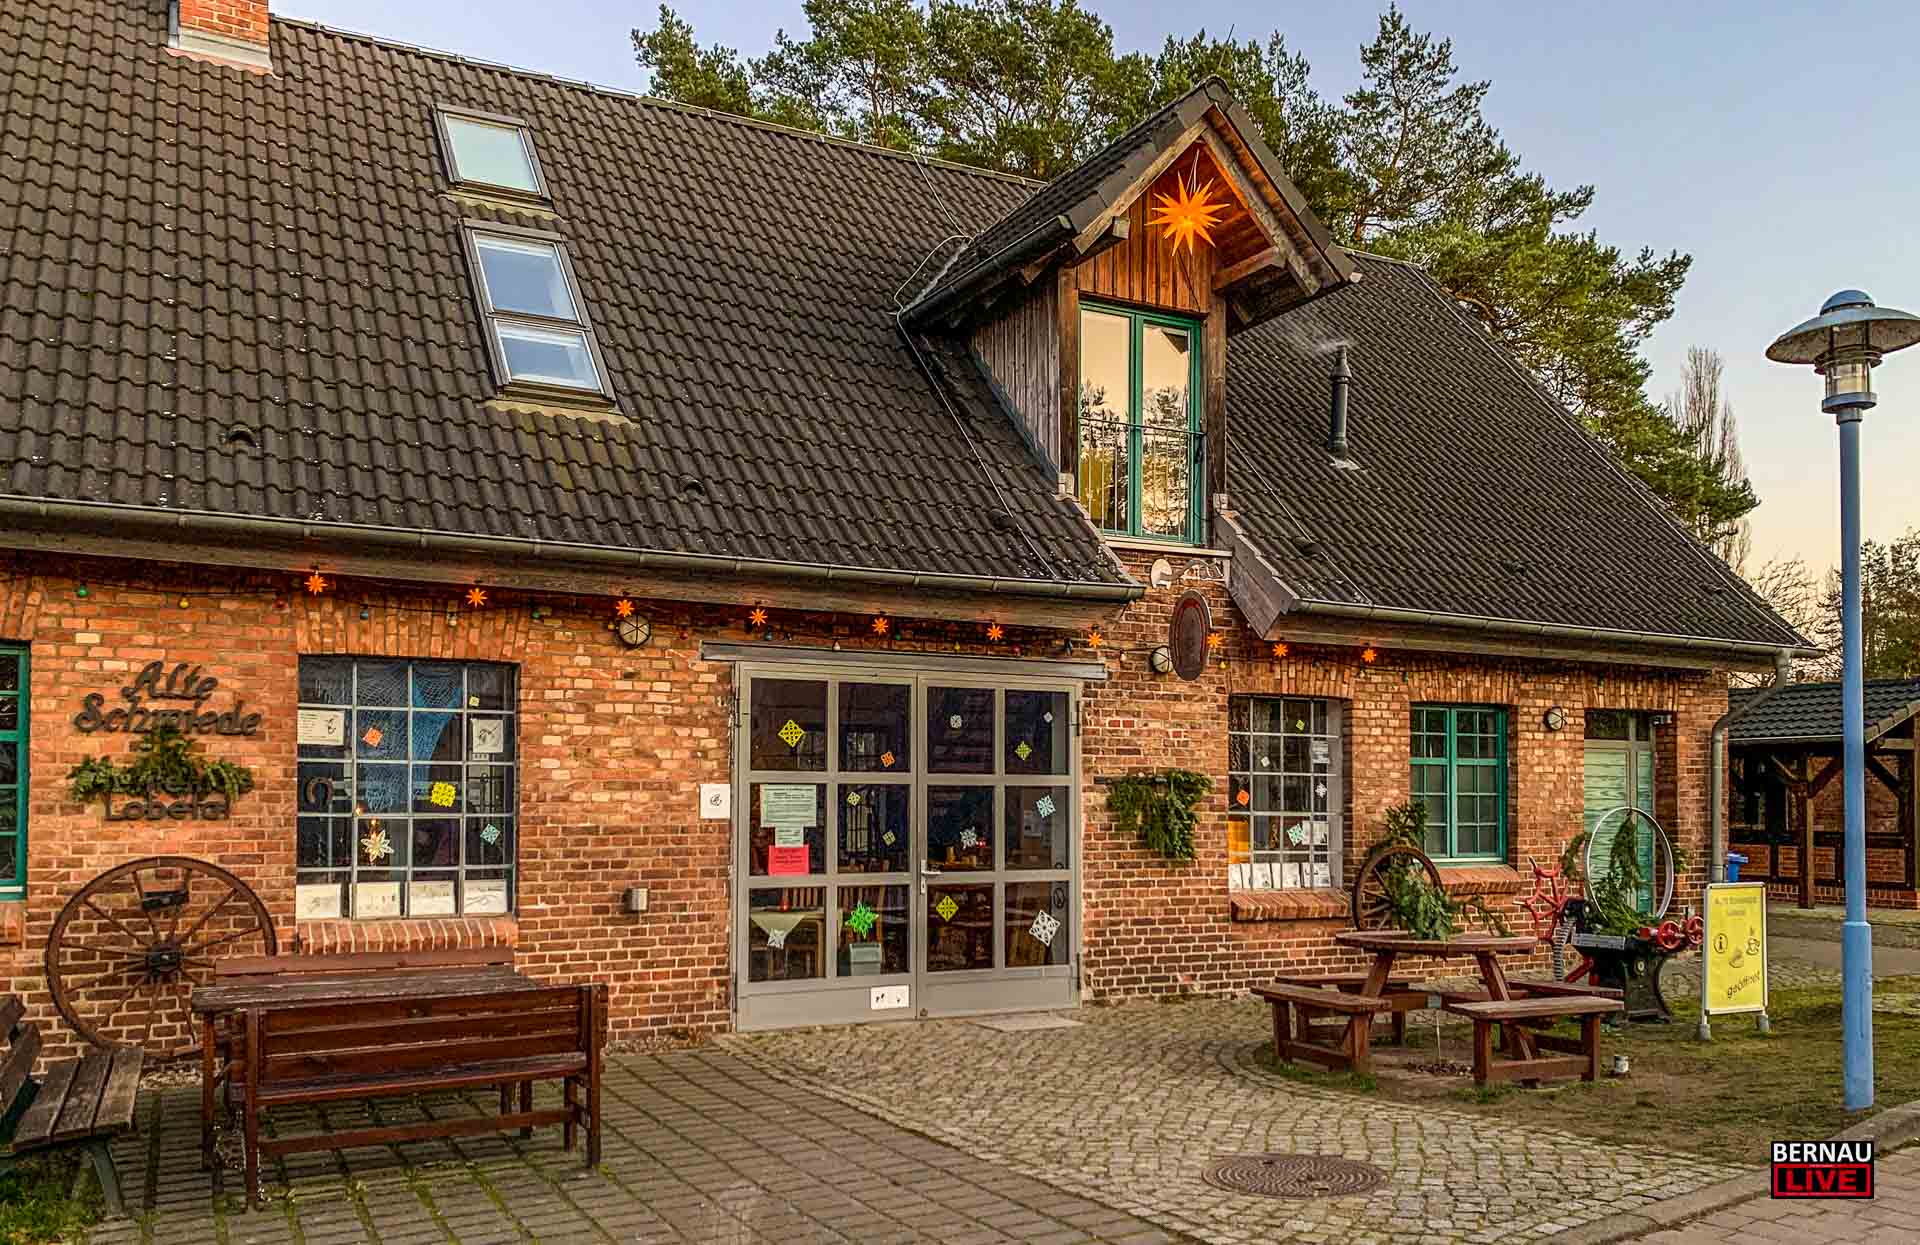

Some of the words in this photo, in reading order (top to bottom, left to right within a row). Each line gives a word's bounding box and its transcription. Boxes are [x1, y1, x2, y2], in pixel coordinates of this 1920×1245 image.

[121, 660, 218, 701] Alte
[74, 692, 261, 735] Schmiede
[105, 784, 231, 821] Lobetal
